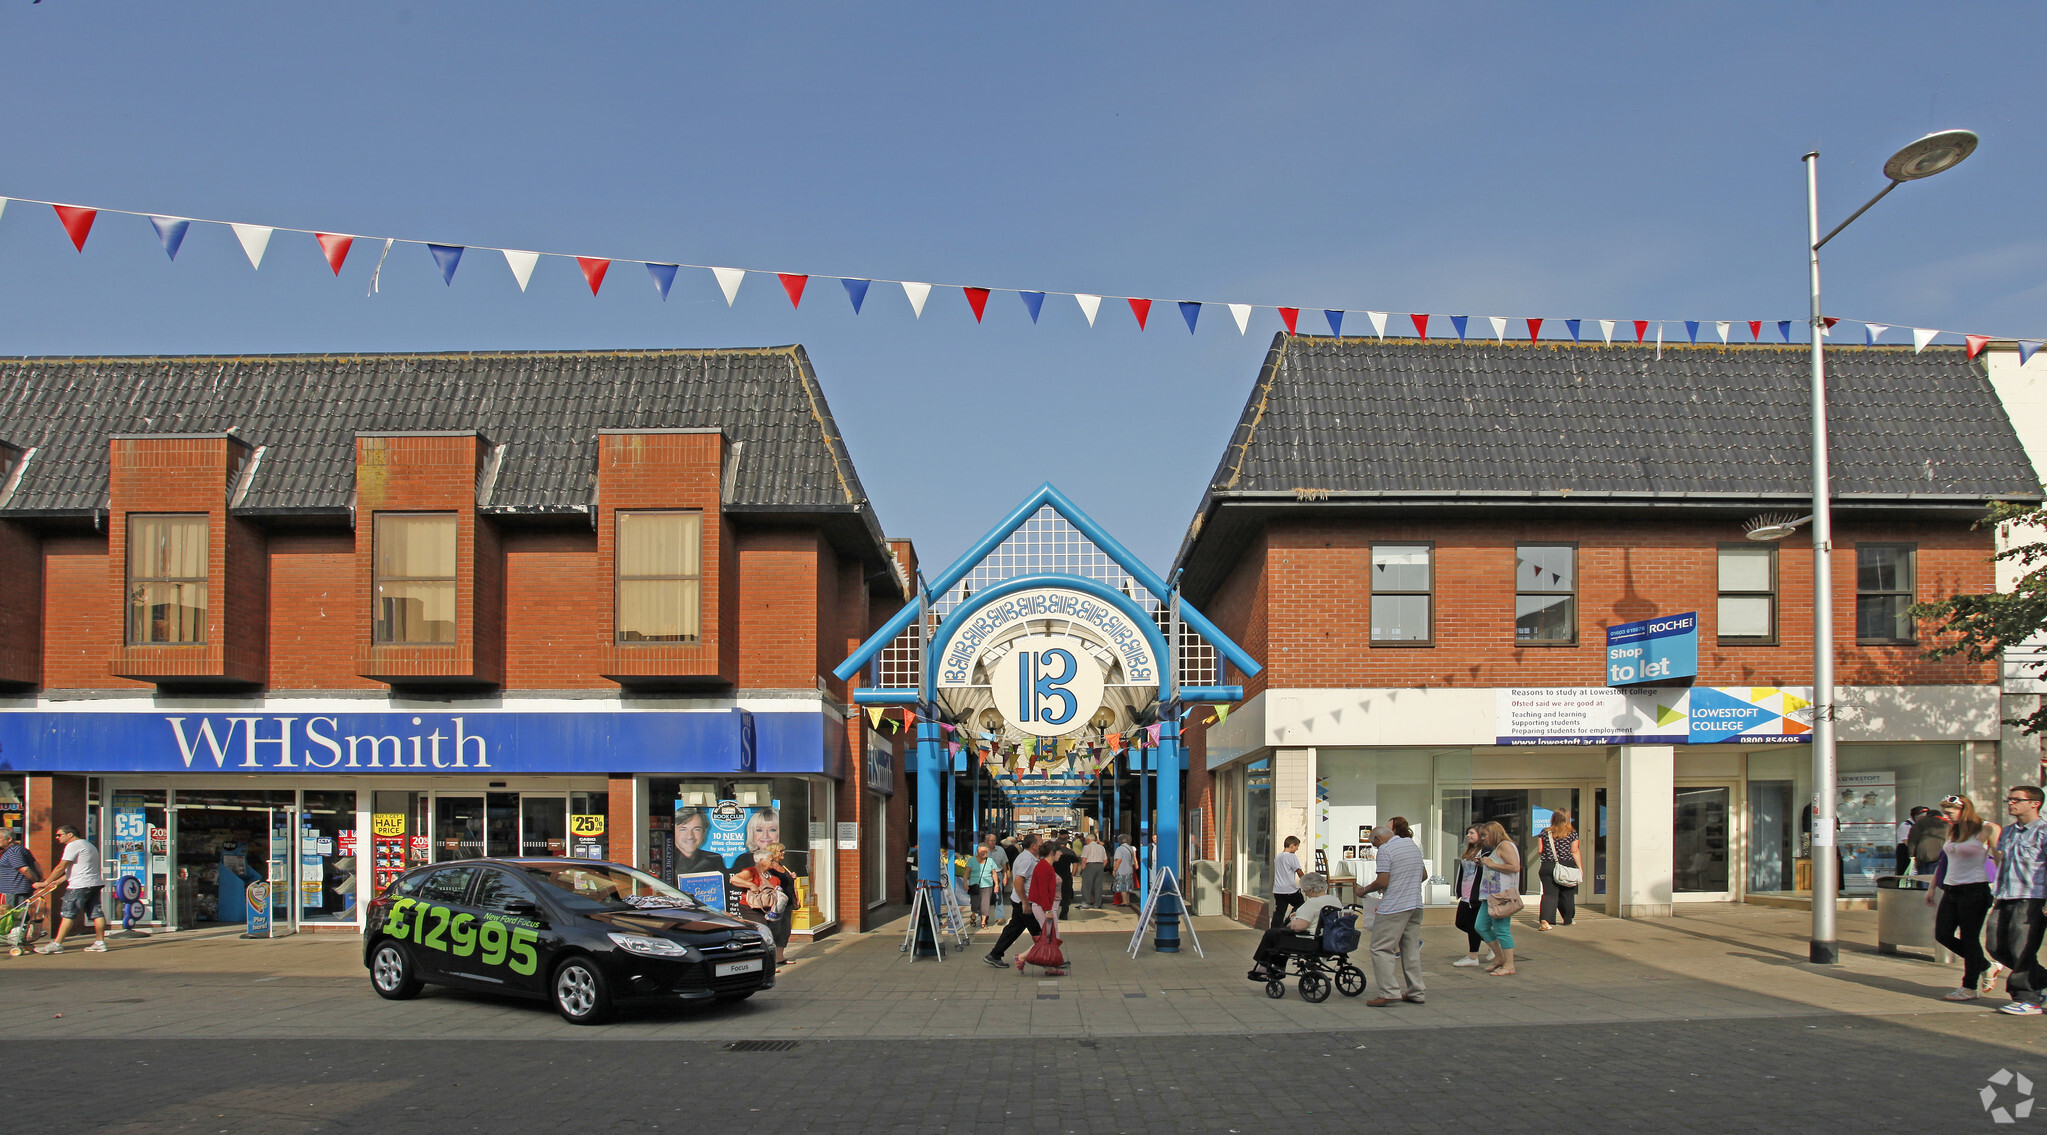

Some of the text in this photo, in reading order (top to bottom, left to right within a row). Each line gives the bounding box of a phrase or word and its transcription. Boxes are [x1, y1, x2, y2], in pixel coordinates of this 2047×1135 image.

[1649, 618, 1689, 633] ROCHE
[1610, 647, 1643, 660] Shop
[1610, 657, 1670, 681] to let
[1556, 689, 1577, 697] study
[1629, 688, 1658, 697] College
[1577, 700, 1594, 708] good
[1511, 711, 1542, 719] Teaching
[1558, 711, 1587, 719] learning
[1692, 708, 1759, 718] LOWESTOFT
[1511, 719, 1549, 727] Supporting
[1692, 721, 1744, 731] COLLEGE
[1589, 727, 1633, 735] employment
[165, 716, 491, 768] WHSmith
[868, 744, 893, 793] HSmith
[115, 814, 144, 837] £5
[375, 819, 403, 827] HALF
[712, 832, 745, 840] 10 NEW
[252, 916, 267, 924] Play
[484, 912, 541, 928] New Ford Focus
[252, 923, 268, 931] here!
[383, 897, 539, 976] £12995
